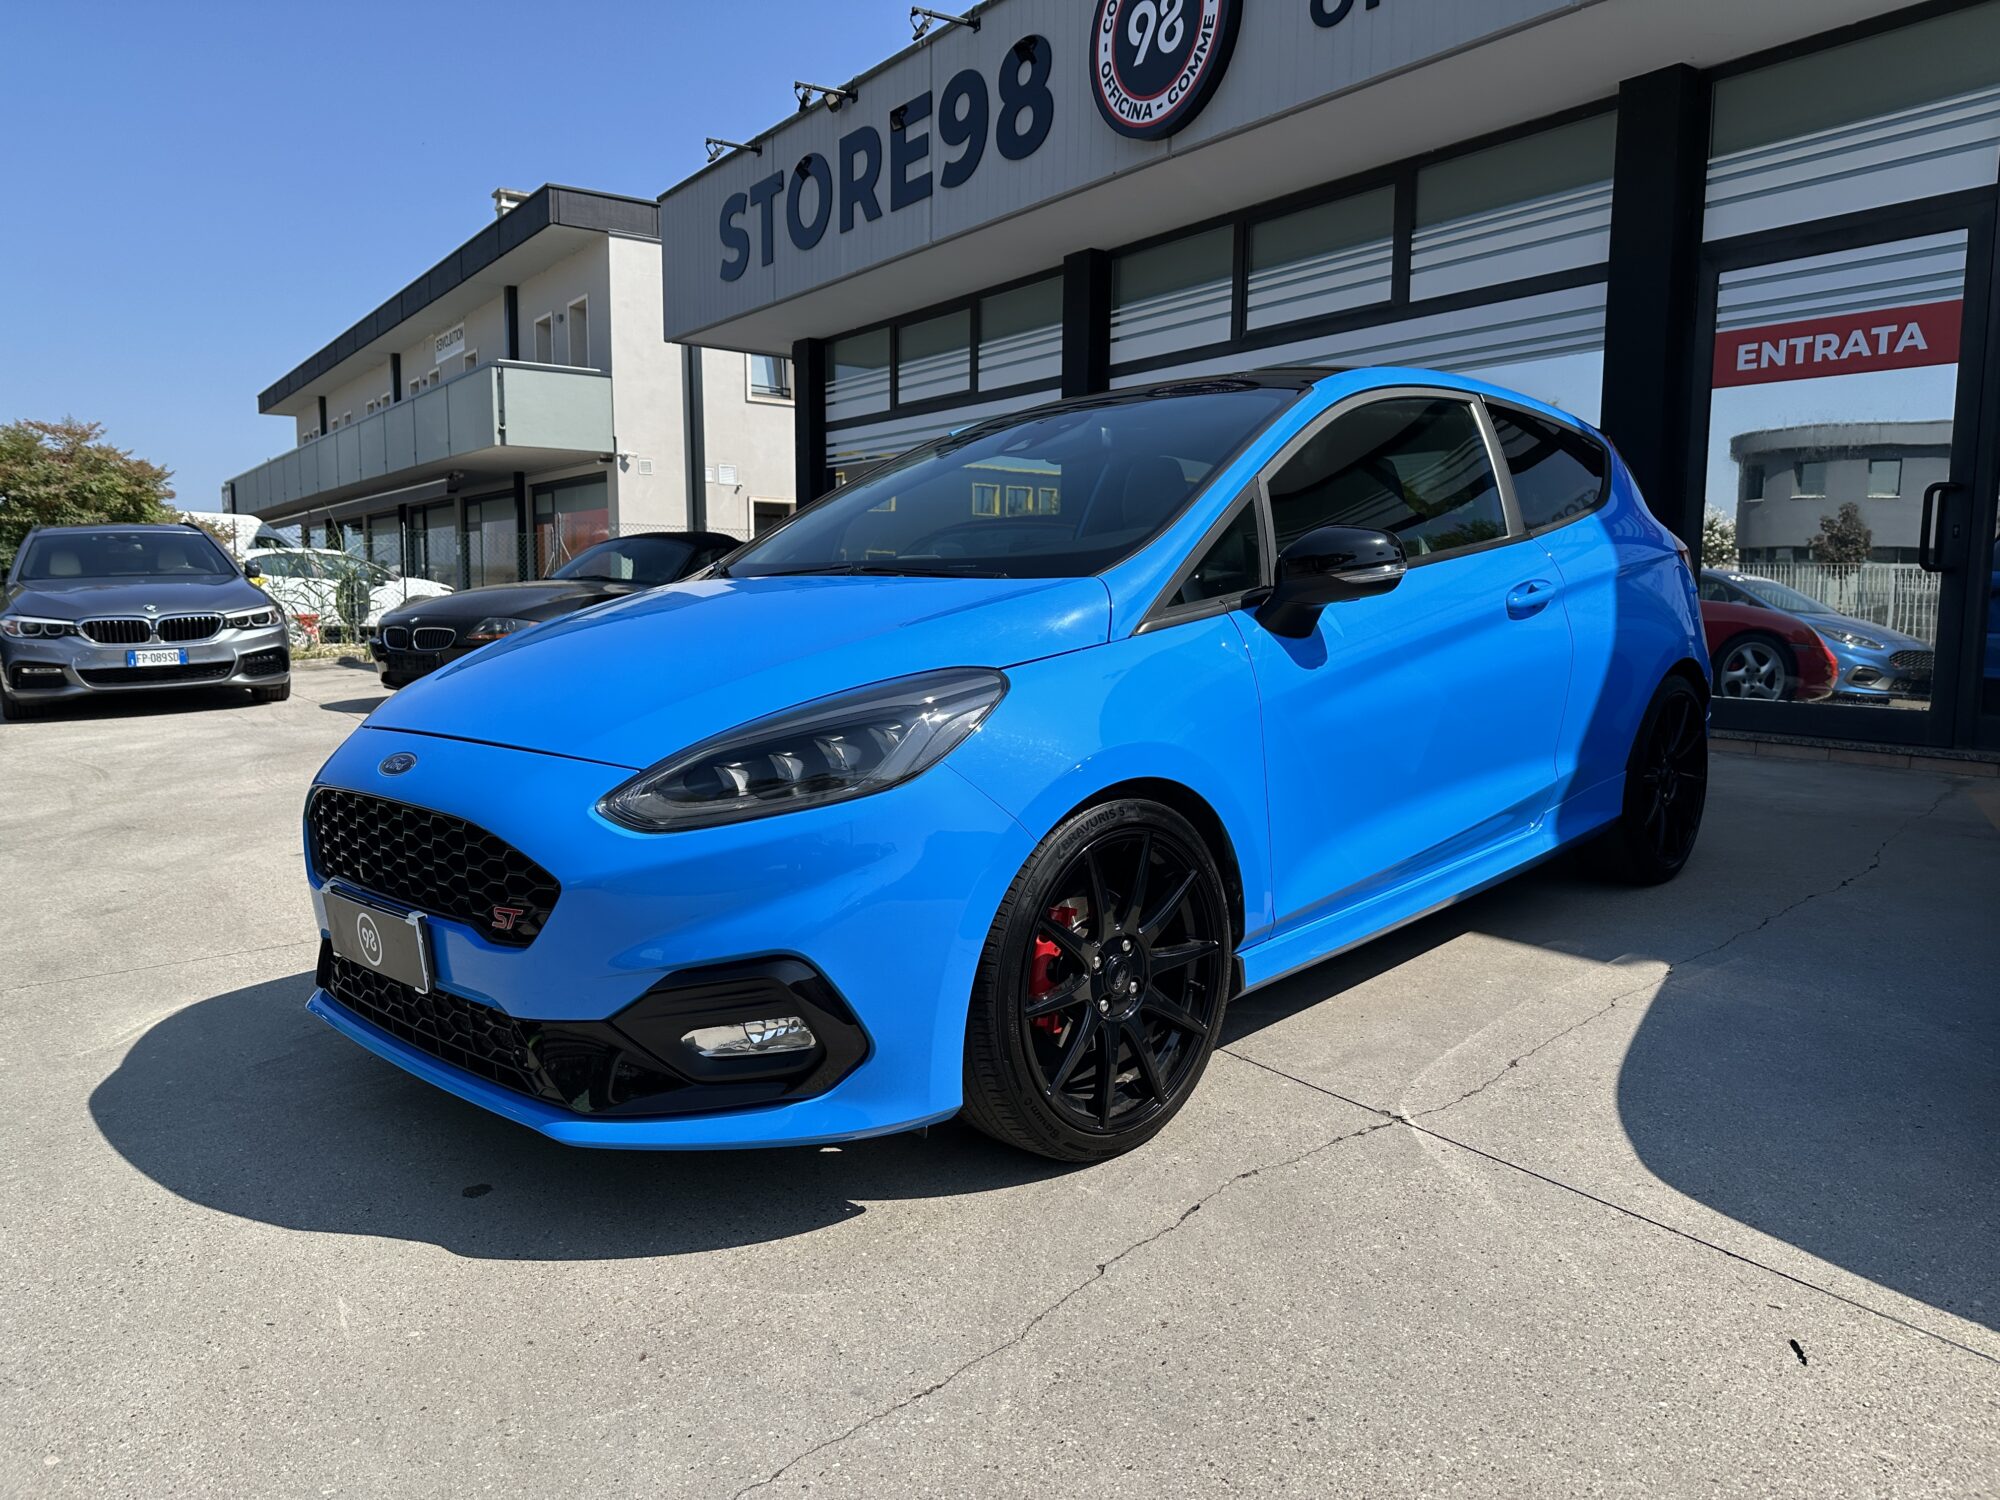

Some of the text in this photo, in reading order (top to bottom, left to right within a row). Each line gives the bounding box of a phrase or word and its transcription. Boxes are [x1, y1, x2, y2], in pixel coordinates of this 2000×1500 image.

[1128, 0, 1184, 67] 98
[1101, 14, 1216, 121] OFFICINA GOMME
[719, 34, 1054, 281] STORE98
[1736, 322, 1928, 371] ENTRATA
[1061, 808, 1117, 851] BRAVURIS
[361, 927, 378, 952] 98
[492, 906, 523, 930] ST
